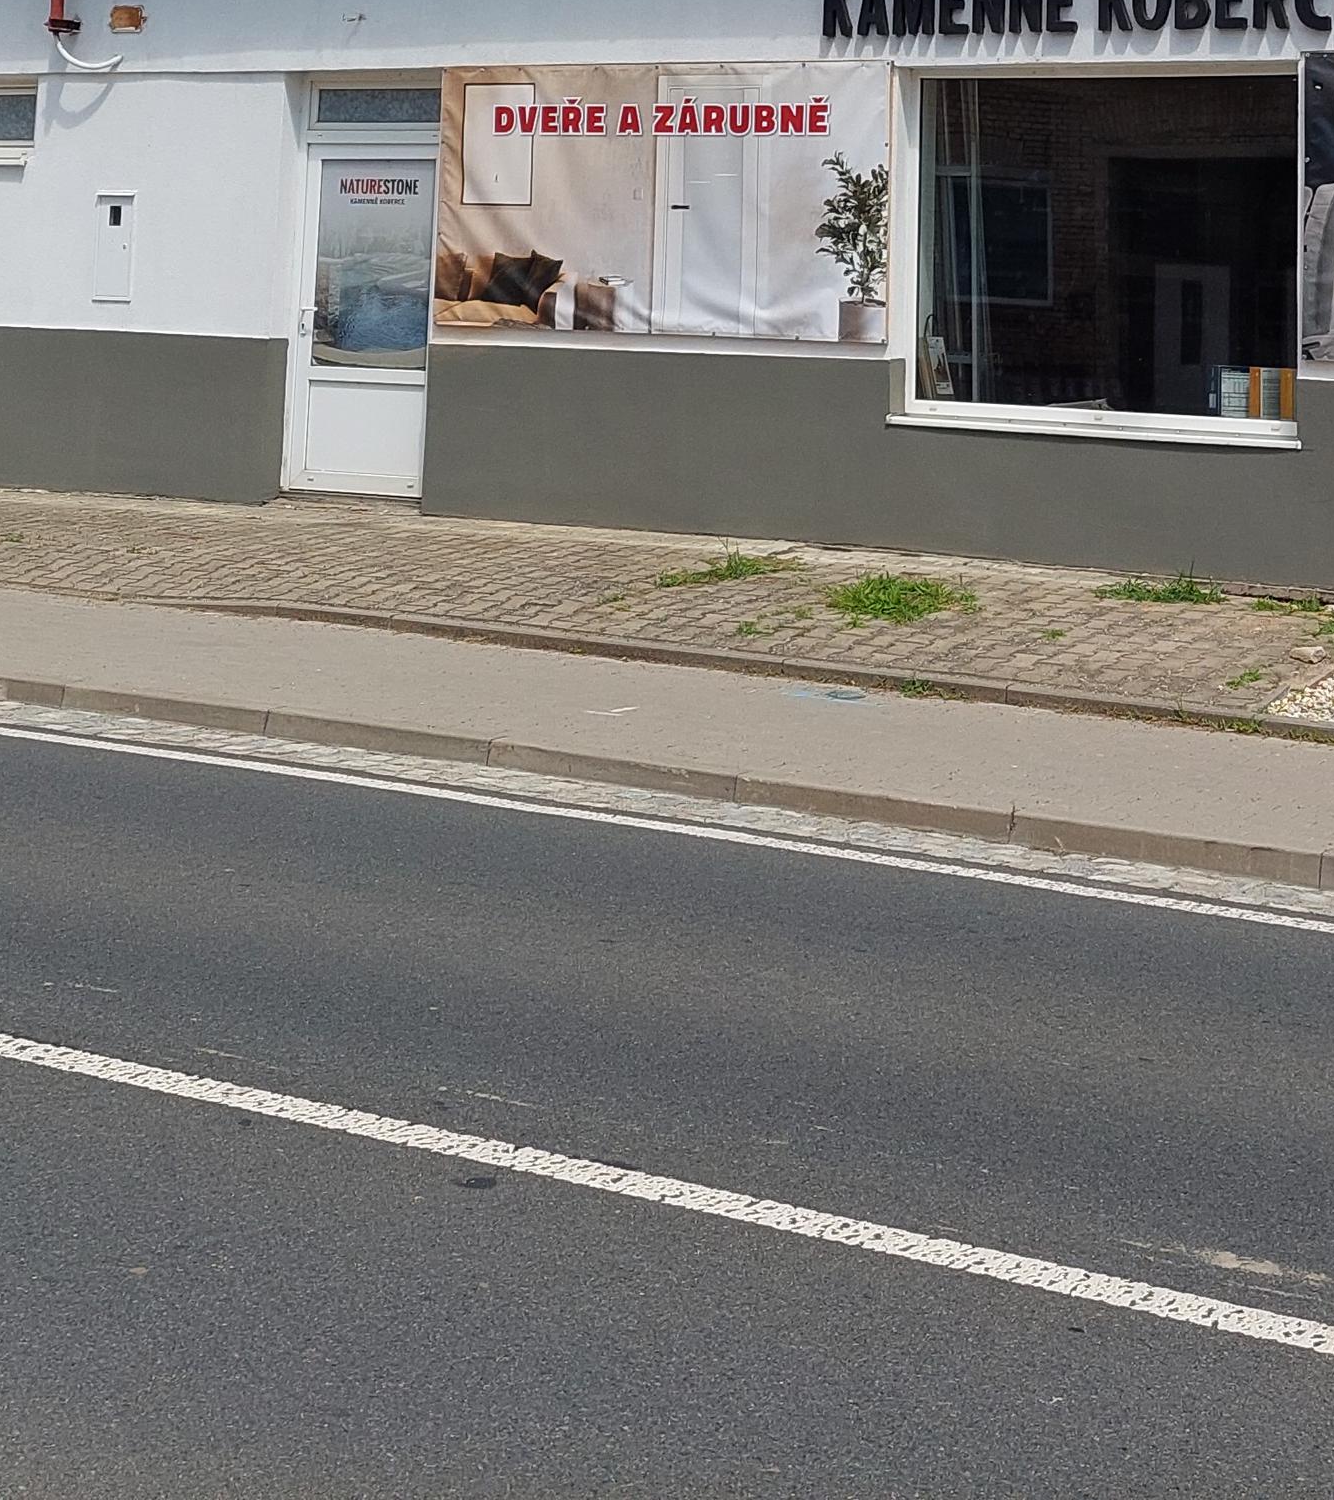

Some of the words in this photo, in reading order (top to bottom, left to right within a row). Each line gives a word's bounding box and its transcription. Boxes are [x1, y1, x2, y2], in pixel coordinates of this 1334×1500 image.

[492, 96, 607, 136] DVEŘE
[617, 103, 643, 136] A
[651, 95, 832, 137] ZÁRUBNĚ
[340, 179, 420, 195] NATURESTONE
